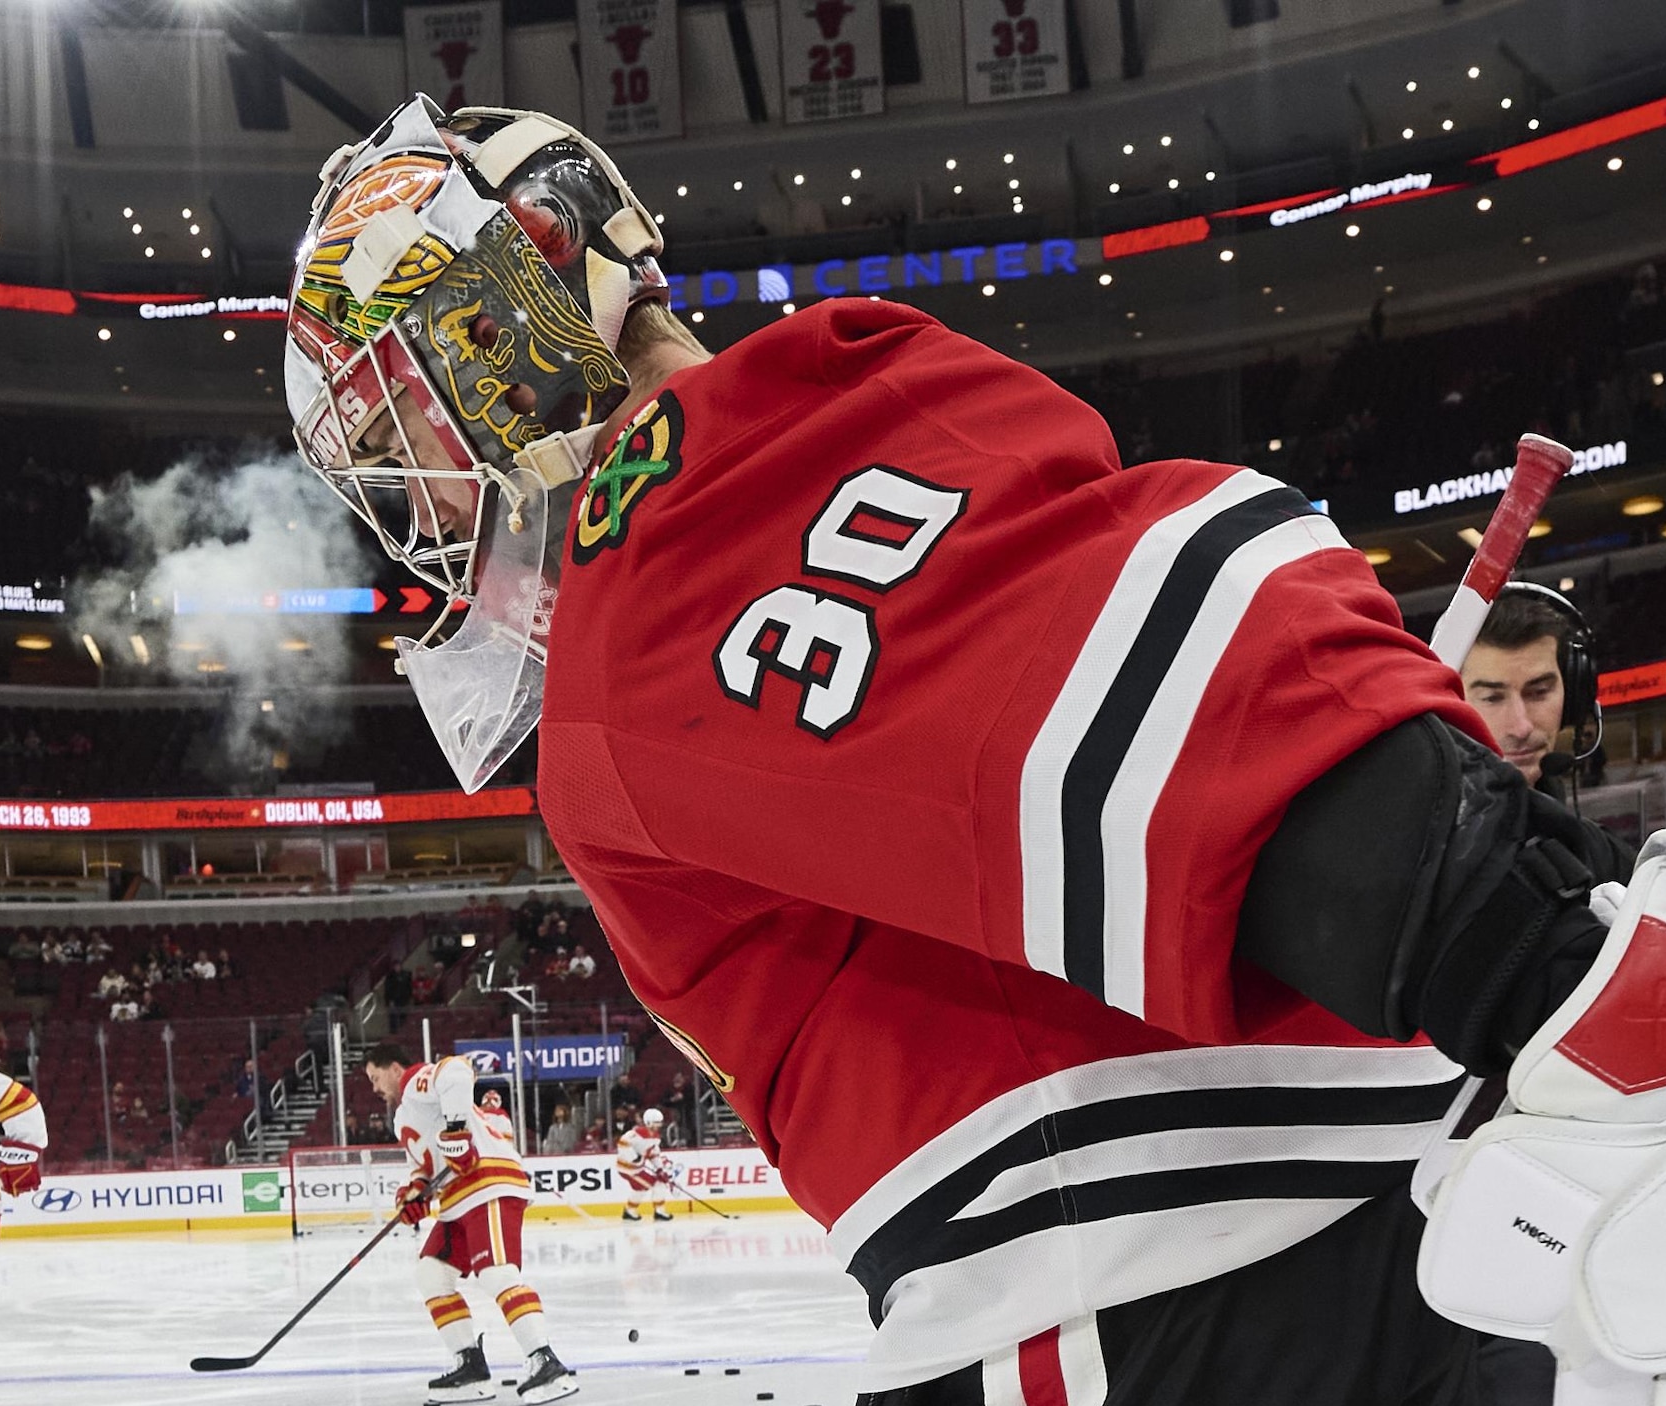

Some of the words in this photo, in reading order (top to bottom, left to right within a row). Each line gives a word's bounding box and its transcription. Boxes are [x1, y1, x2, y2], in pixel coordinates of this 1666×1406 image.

[992, 17, 1039, 57] 33
[808, 42, 856, 82] 23
[611, 67, 650, 105] 10
[1269, 193, 1350, 227] Connor
[1349, 172, 1433, 204] Murphy
[813, 238, 1078, 297] CENTER
[139, 302, 216, 320] Connor
[712, 463, 973, 741] 30
[264, 802, 324, 823] DUBLIN,
[324, 801, 351, 823] OH,
[351, 799, 383, 820] USA
[505, 1045, 622, 1071] HYUNDAI
[534, 1167, 613, 1193] EPSI
[687, 1165, 768, 1187] BELLE
[92, 1183, 223, 1209] HYUNDAI
[1512, 1215, 1568, 1255] KNIGHT
